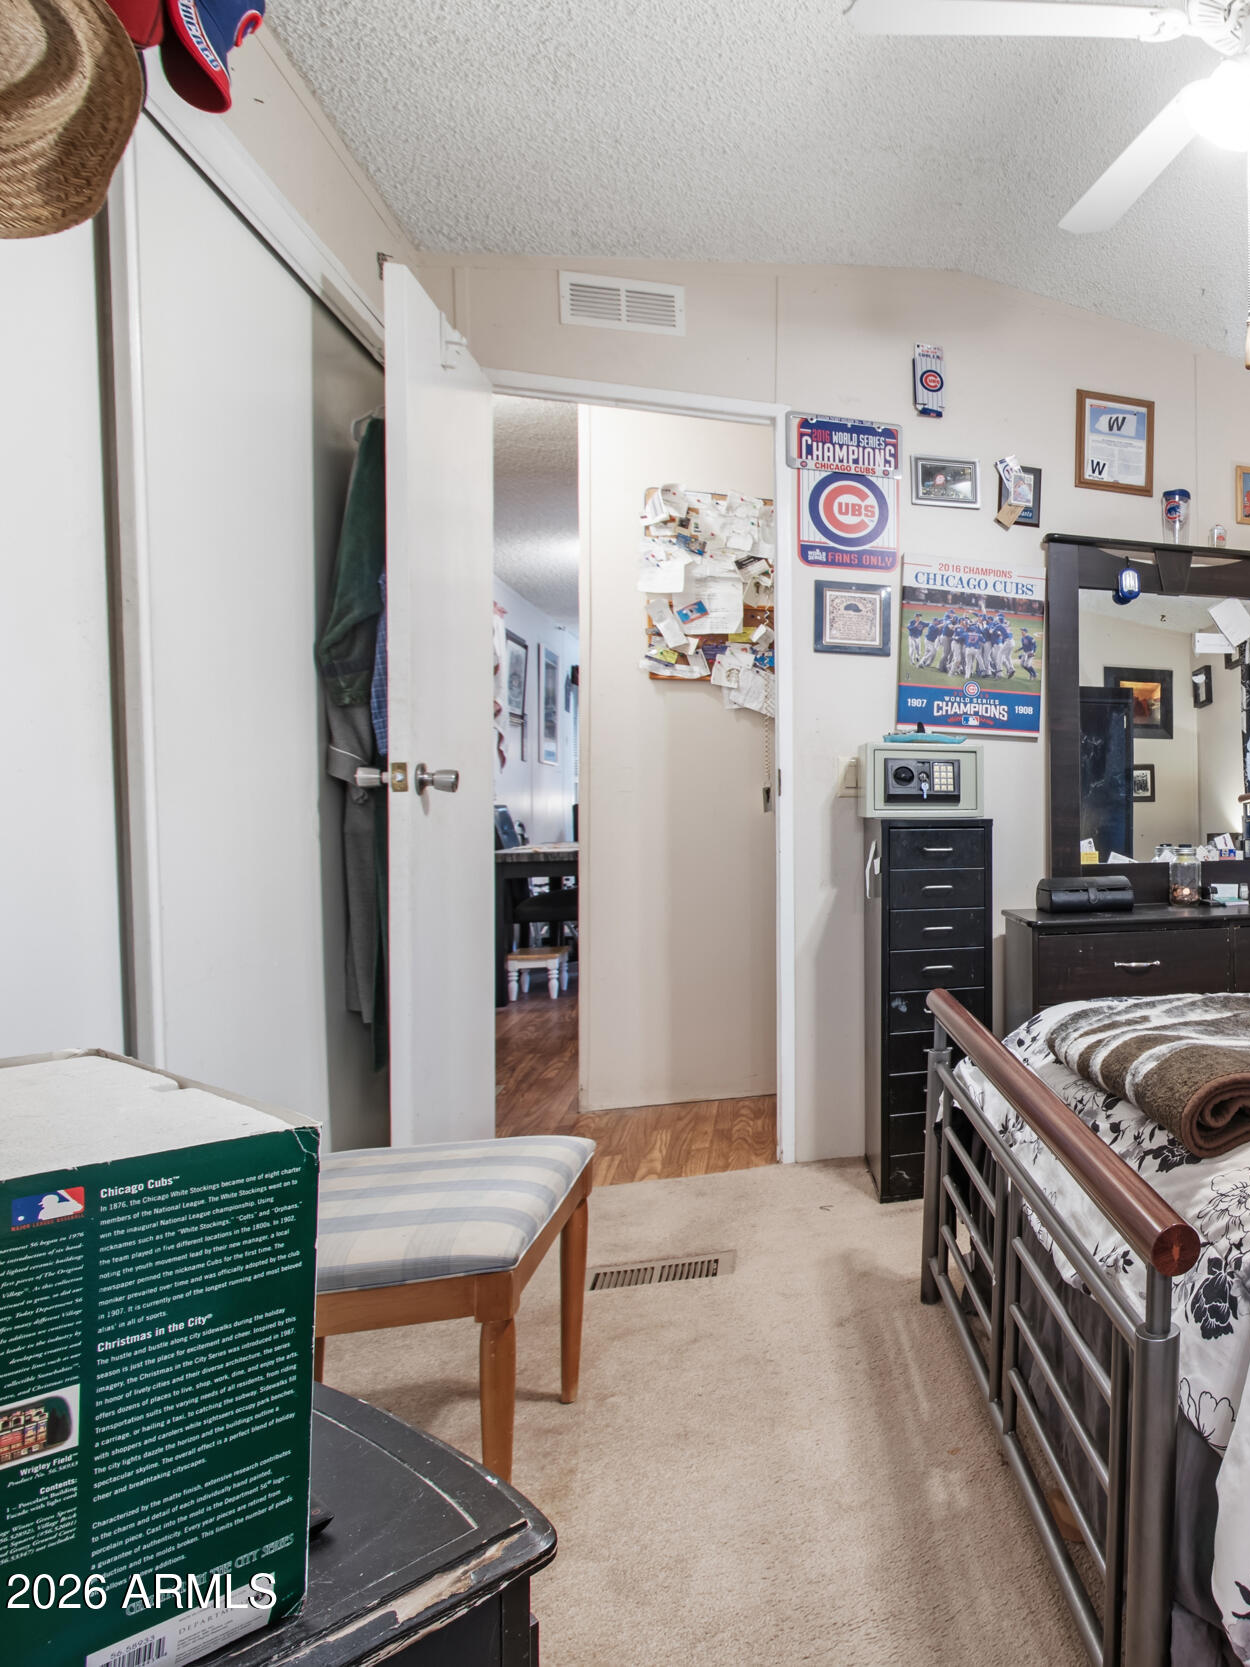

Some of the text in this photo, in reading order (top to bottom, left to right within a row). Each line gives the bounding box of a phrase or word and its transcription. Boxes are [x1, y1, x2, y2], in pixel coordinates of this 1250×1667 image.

[178, 0, 220, 71] HICAGO
[1108, 416, 1127, 431] W
[811, 430, 885, 448] 2016 WORLD SERIES
[801, 436, 895, 470] CHAMPIONS
[815, 462, 876, 475] CHICAGO CUBS
[1091, 459, 1106, 476] W
[828, 552, 893, 566] FANS ONLY
[939, 563, 1013, 579] 2016 CHAMPIONS
[915, 571, 1034, 596] CHICAGO CUBS
[907, 699, 927, 707] 1907
[933, 701, 1008, 721] CHAMPIONS
[1015, 706, 1033, 714] 1908
[100, 1181, 143, 1199] Chicago
[142, 1191, 168, 1205] Chicago
[170, 1187, 188, 1198] White
[189, 1181, 219, 1195] Stockings
[220, 1176, 244, 1187] became
[264, 1169, 279, 1180] eight
[280, 1165, 300, 1175] charter
[96, 1329, 152, 1352] Christmas
[155, 1325, 164, 1336] in
[167, 1320, 184, 1333] the
[111, 1349, 131, 1362] hustle
[148, 1339, 167, 1351] bustle
[170, 1334, 187, 1346] along
[189, 1330, 200, 1341] city
[202, 1321, 231, 1336] sidewalks
[233, 1315, 252, 1328] during
[264, 1306, 284, 1319] holiday
[19, 1460, 50, 1477] Wrigley
[39, 1475, 77, 1495] Contents:
[92, 1488, 113, 1503] cheer
[127, 1467, 171, 1491] breathtaking
